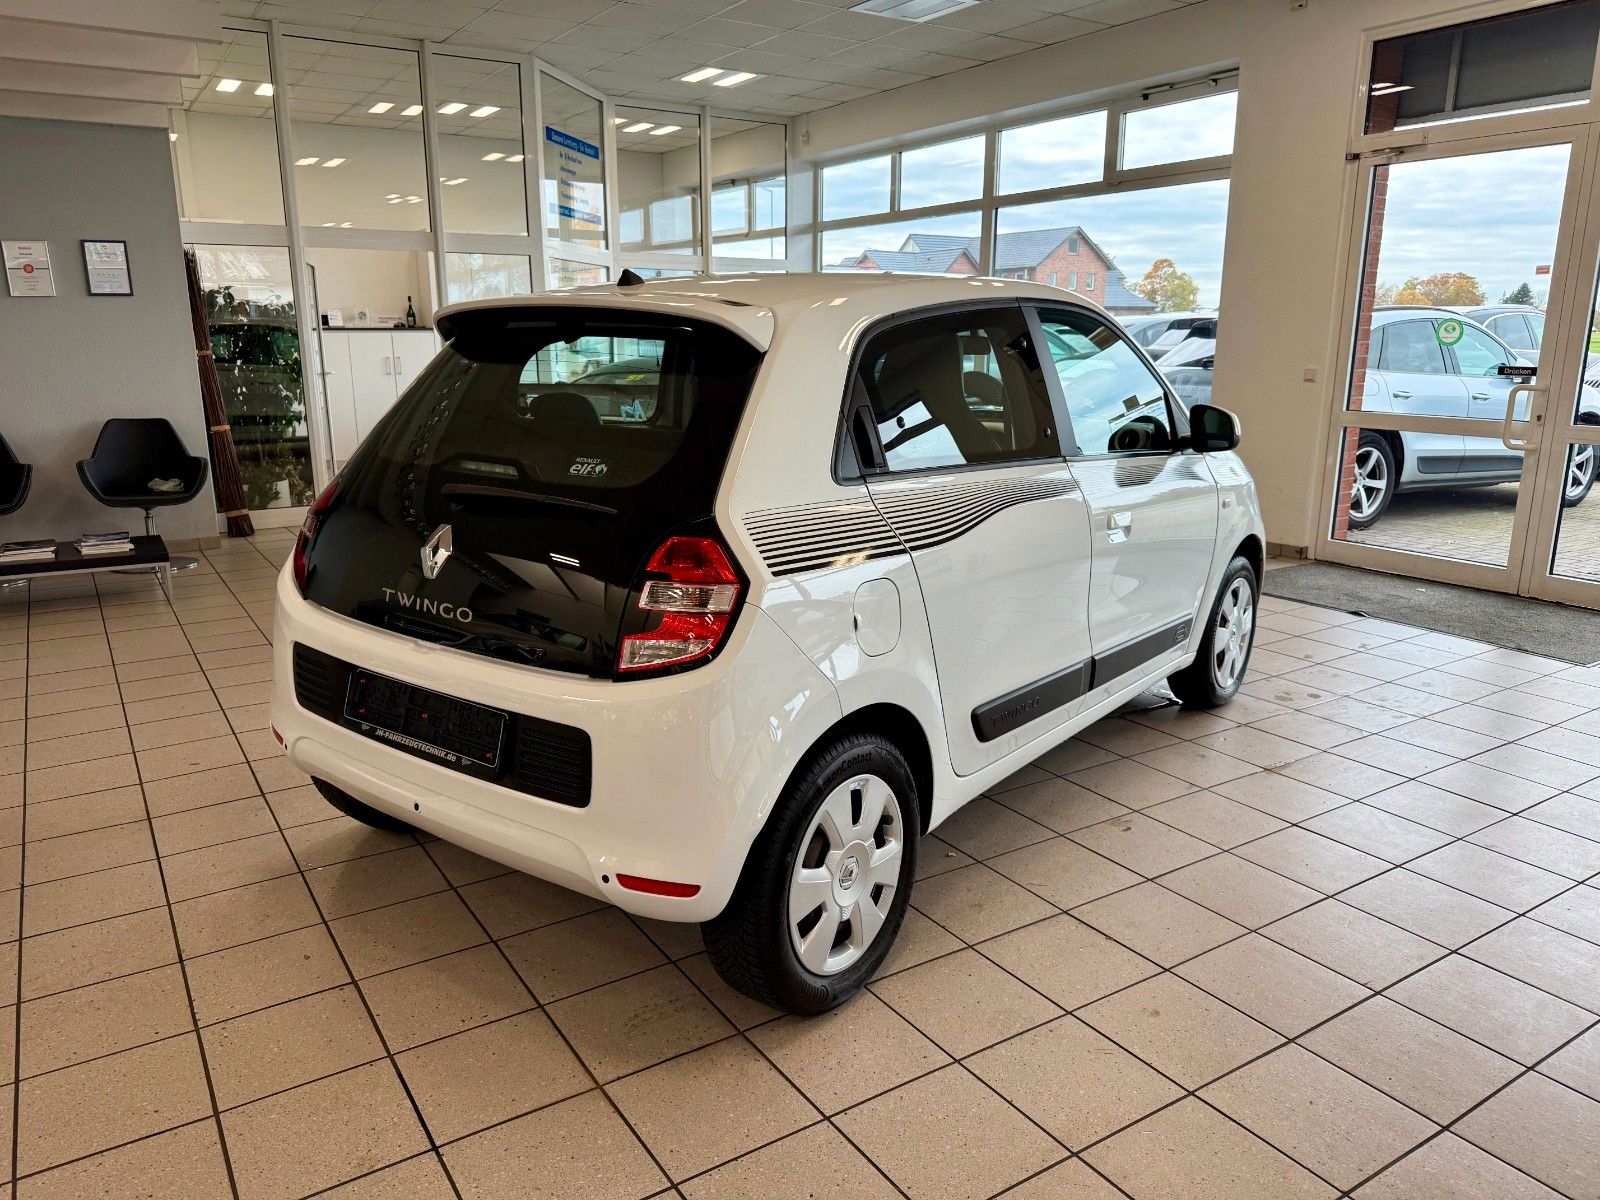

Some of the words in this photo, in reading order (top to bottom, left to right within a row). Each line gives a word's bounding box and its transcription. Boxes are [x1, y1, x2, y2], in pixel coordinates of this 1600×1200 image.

[1504, 367, 1532, 375] Drücken
[569, 463, 596, 475] elf
[382, 587, 473, 623] TWINGO
[990, 696, 1040, 727] TWINGO
[375, 728, 457, 762] JH-FAHRZEUGTECHNIK.de
